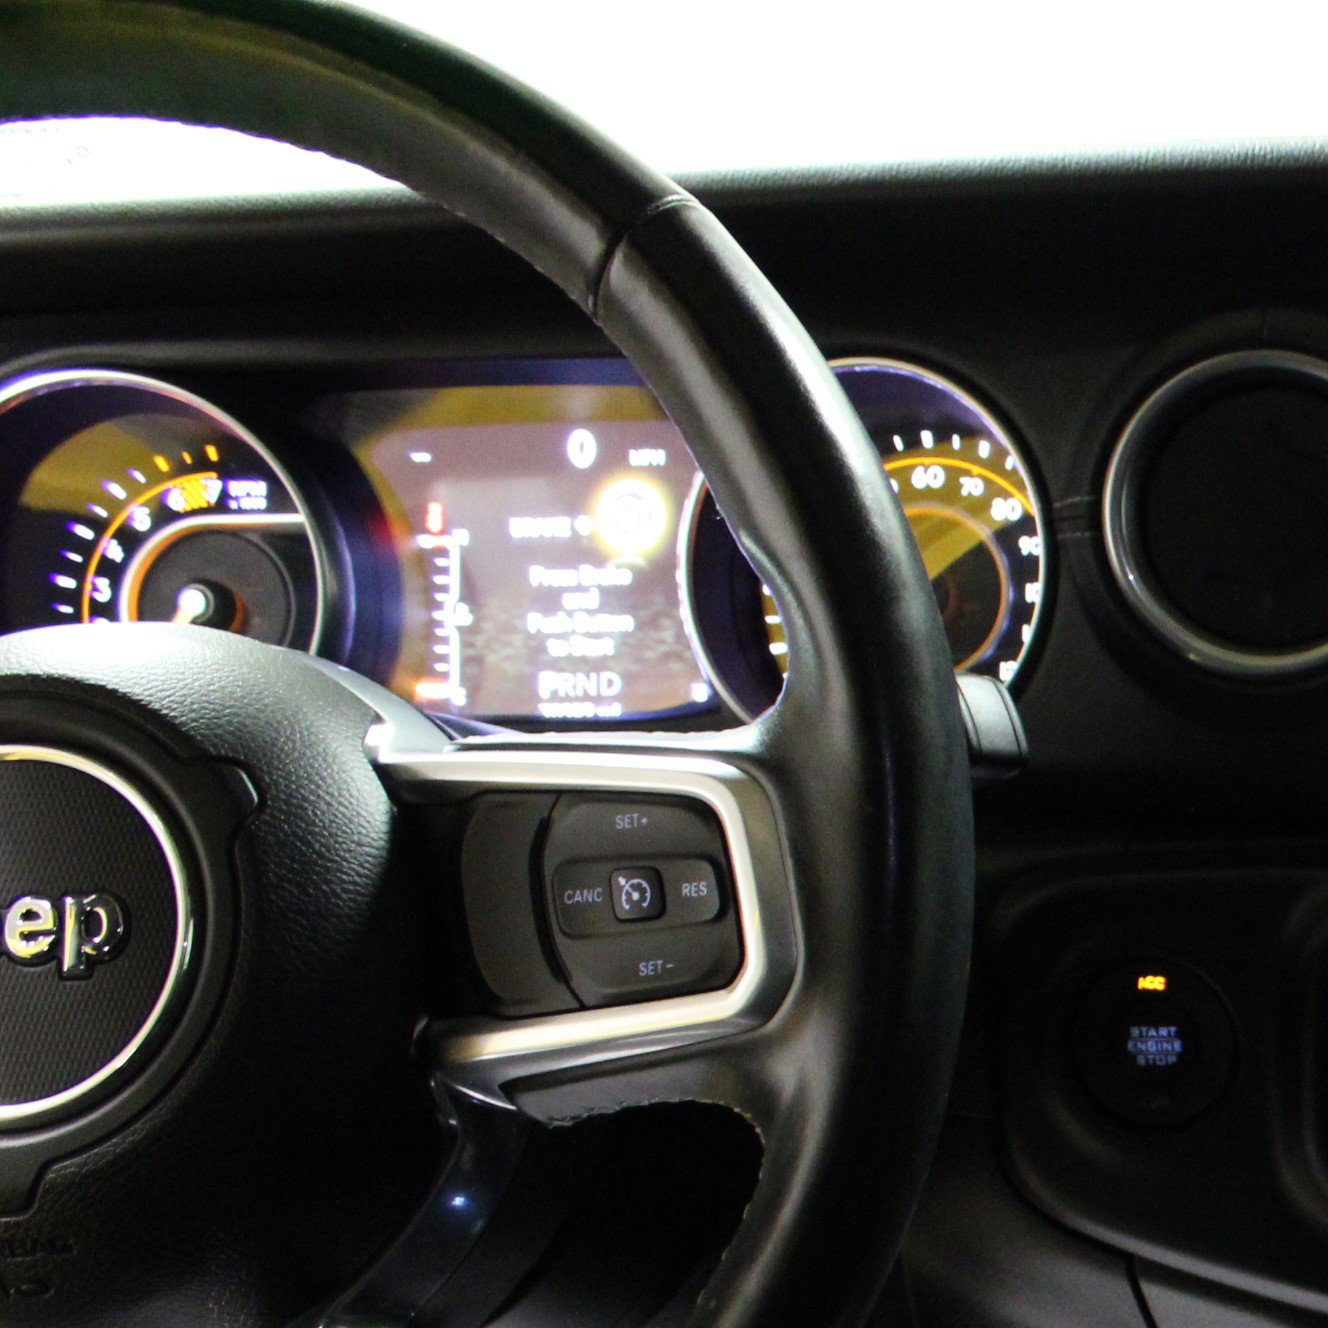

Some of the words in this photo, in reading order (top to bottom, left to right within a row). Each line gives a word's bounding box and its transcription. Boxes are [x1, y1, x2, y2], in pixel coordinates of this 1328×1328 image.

[911, 464, 946, 490] 60
[958, 477, 985, 497] 70
[990, 498, 1023, 522] 80
[563, 888, 604, 905] CANC
[681, 882, 708, 898] RES
[1129, 1026, 1178, 1038] START
[1127, 1040, 1182, 1052] ENGINE
[1136, 1055, 1178, 1066] STOP
